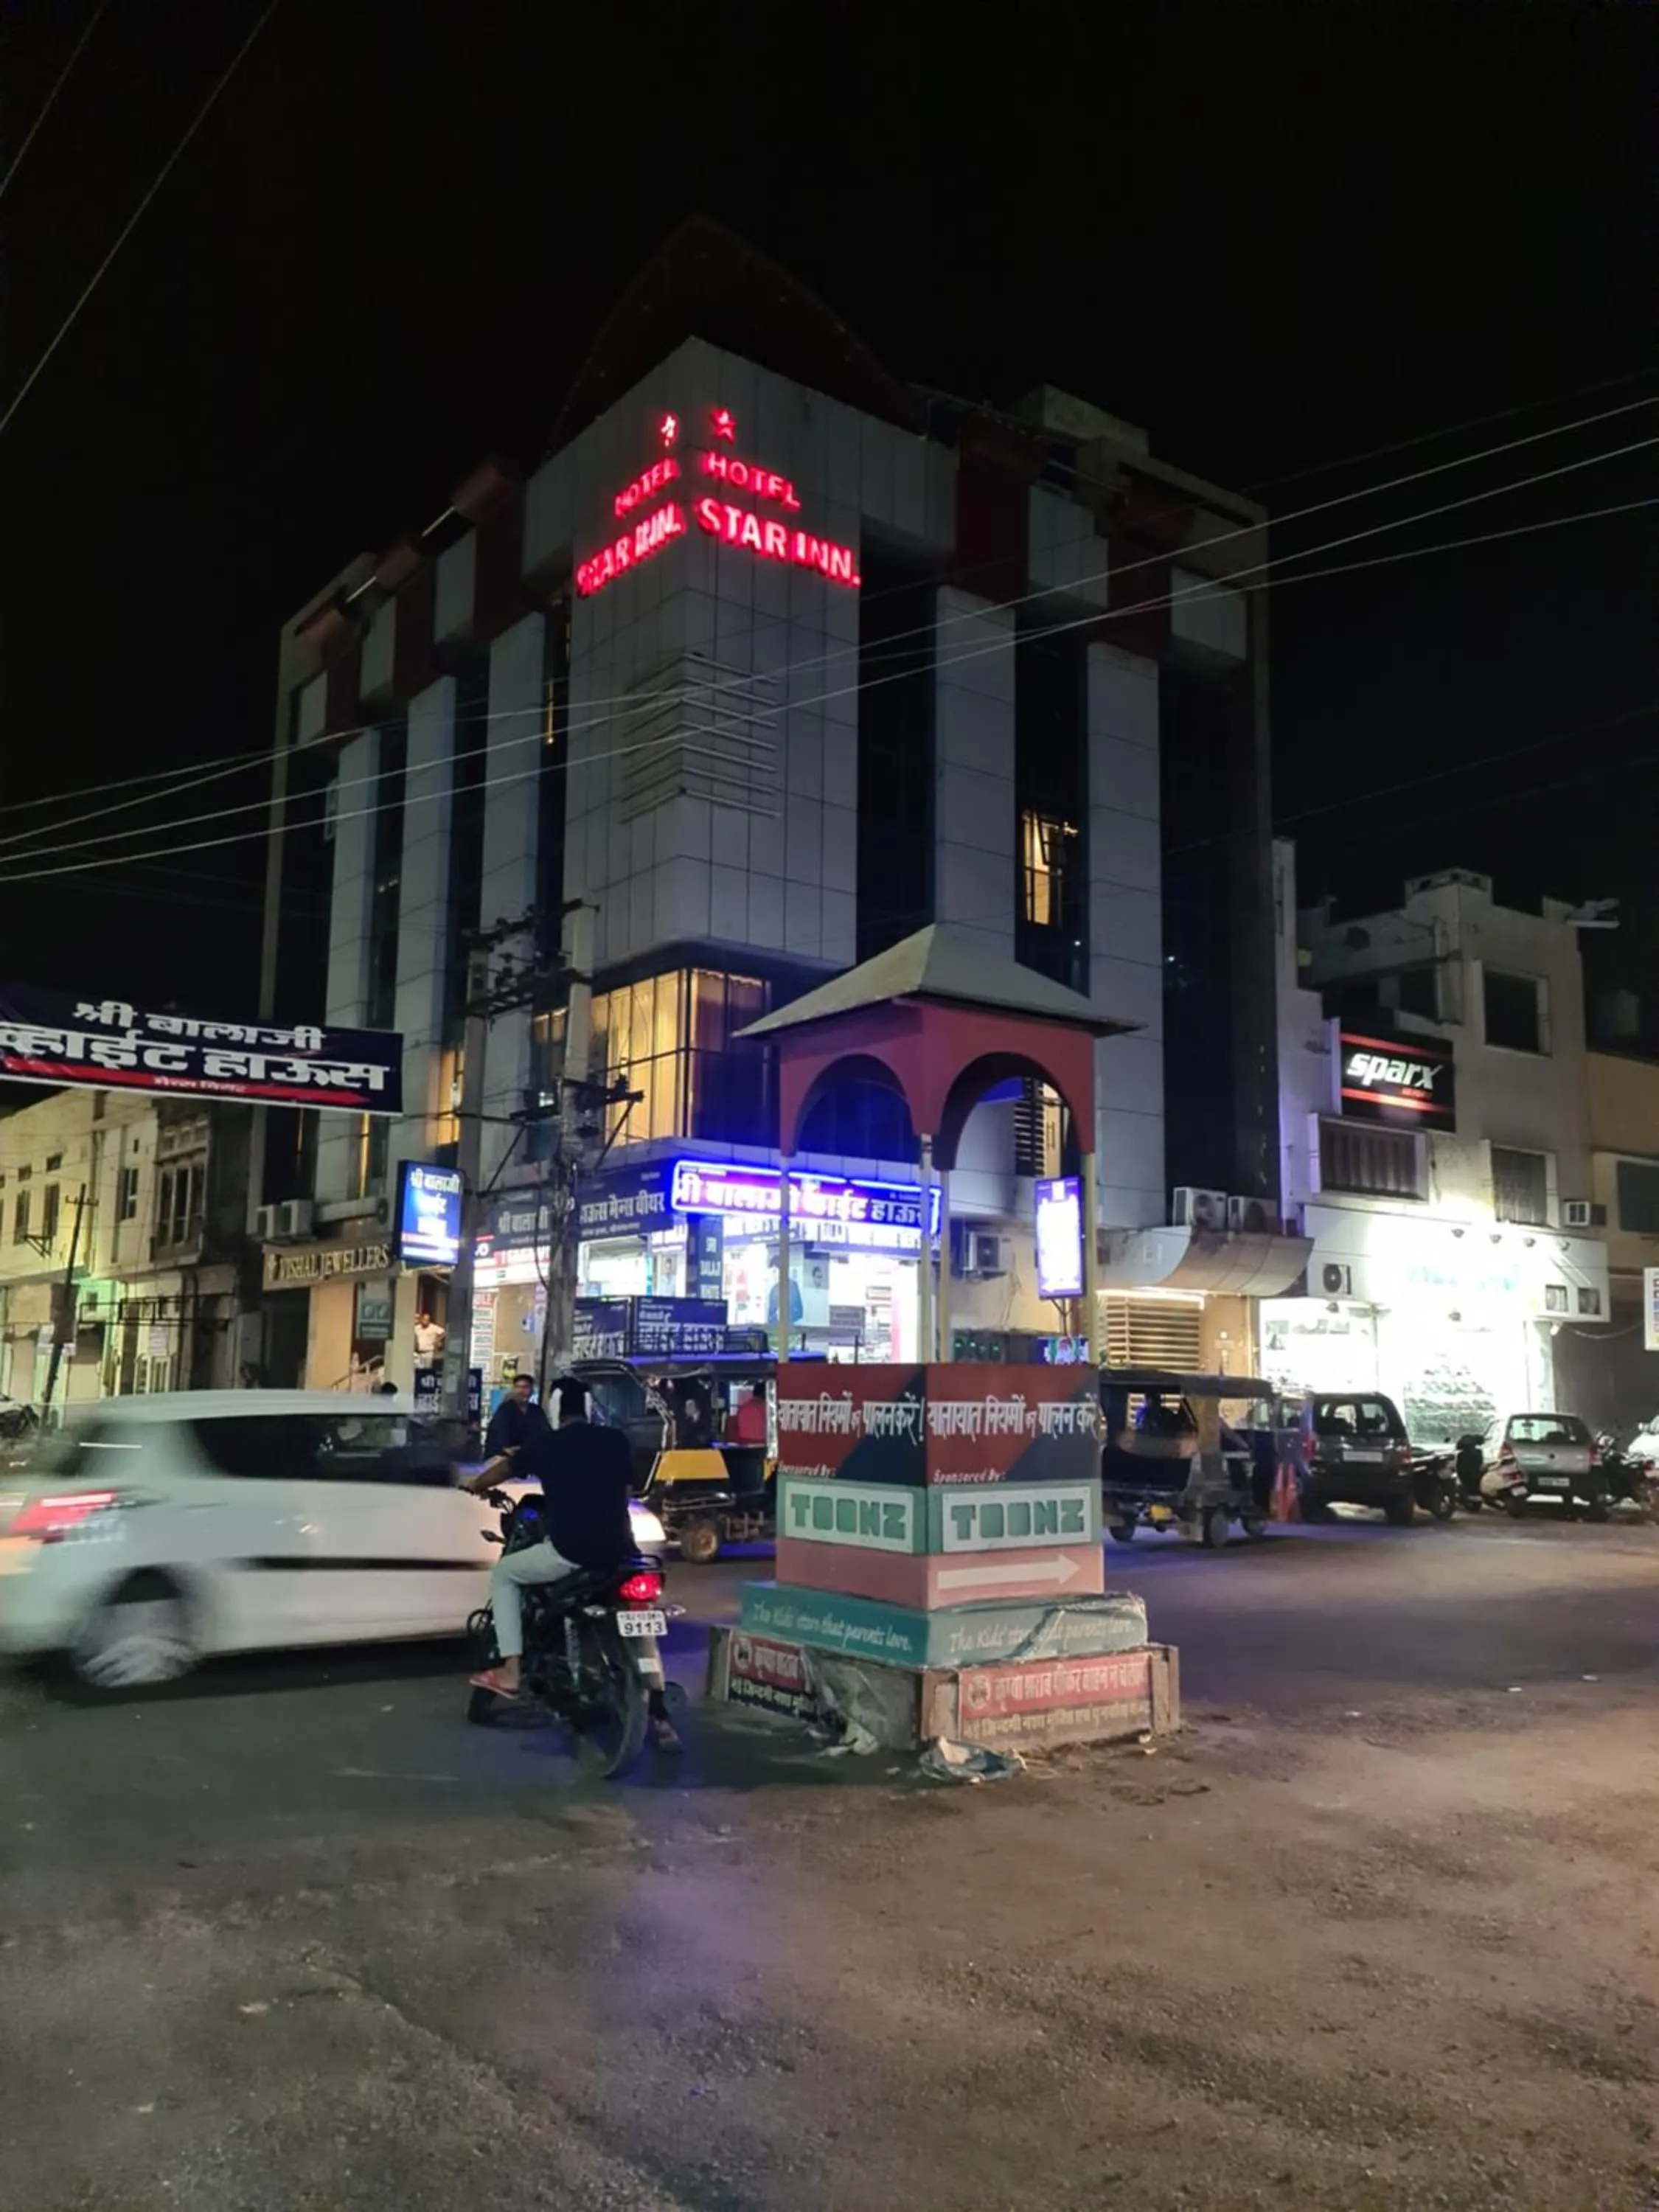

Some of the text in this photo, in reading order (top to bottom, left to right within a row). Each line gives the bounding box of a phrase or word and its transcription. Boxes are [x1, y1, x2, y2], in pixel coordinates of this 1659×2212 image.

[615, 457, 678, 515] HOTEL
[706, 451, 801, 509] HOTEL
[697, 498, 787, 557] STAR
[577, 536, 632, 596] STAR
[73, 1000, 326, 1050] श्री बालाजी
[204, 1047, 390, 1090] हाऊस
[1346, 1052, 1443, 1090] sparx
[871, 1199, 924, 1225] हाऊ
[279, 1243, 389, 1280] VISHAL JEWELLERS
[778, 1399, 817, 1433] यातायात
[817, 1391, 853, 1435] नियमों
[863, 1401, 896, 1440] पालन
[927, 1402, 984, 1443] यातायात
[984, 1394, 1026, 1436] नियमों
[1037, 1402, 1077, 1439] पालन
[933, 1468, 986, 1485] Sponsored
[790, 1493, 906, 1540] TOONZ
[950, 1499, 1085, 1540] TOONZ
[625, 1621, 662, 1635] 9113
[842, 1621, 885, 1649] parents
[950, 1624, 973, 1652] The
